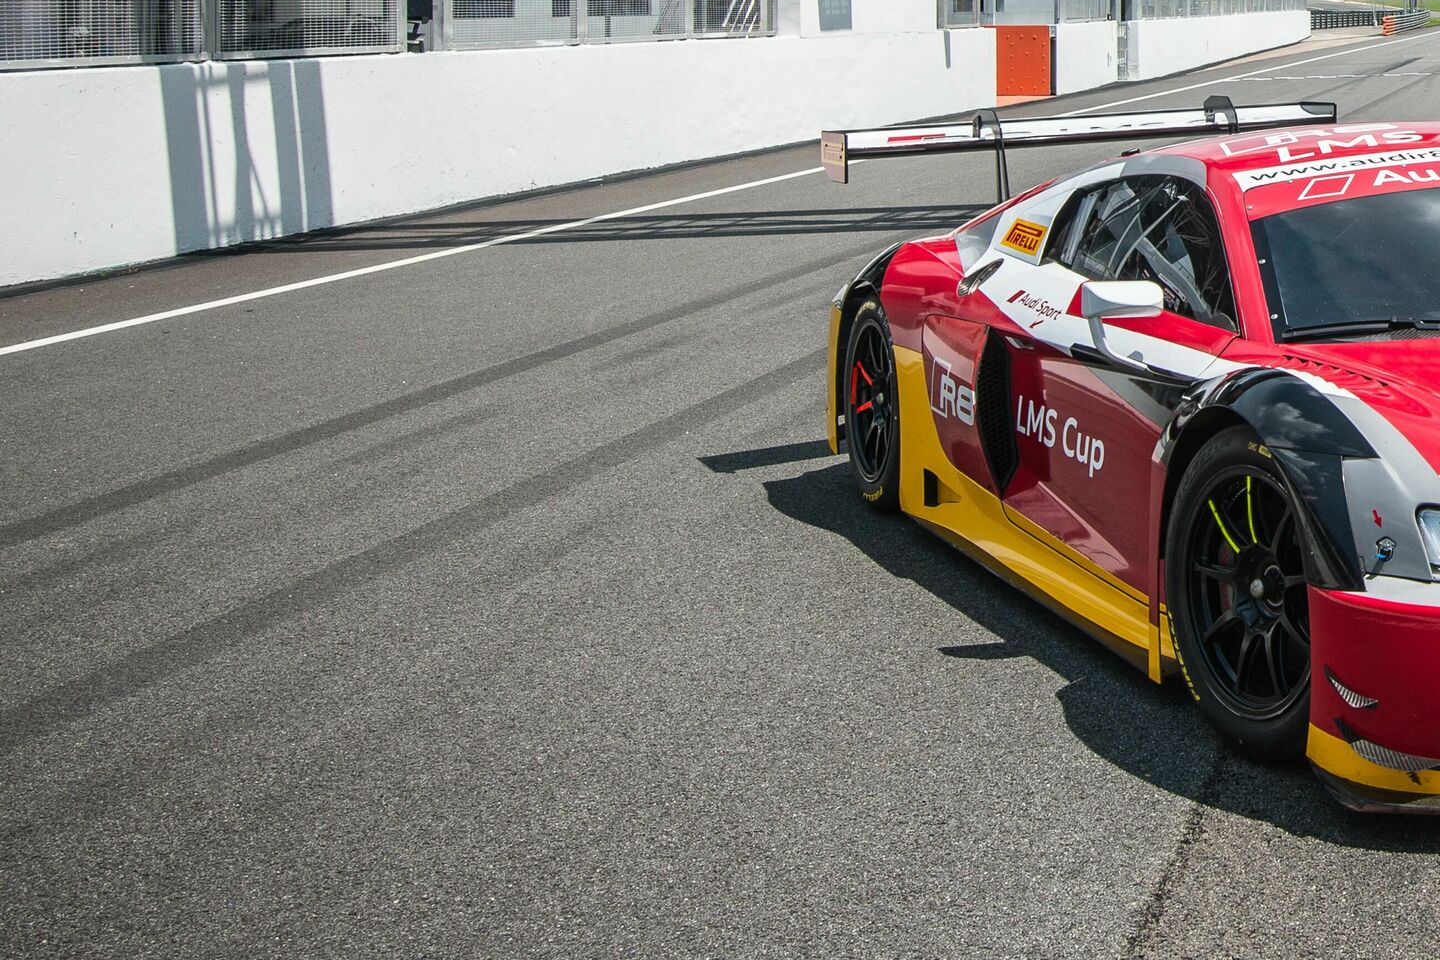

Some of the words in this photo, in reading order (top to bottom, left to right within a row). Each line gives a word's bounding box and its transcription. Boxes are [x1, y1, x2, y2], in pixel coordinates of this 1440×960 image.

[1277, 130, 1423, 163] LMS
[1006, 223, 1043, 251] PIRELLI
[1019, 293, 1038, 310] Audi
[1036, 300, 1062, 320] Sport
[939, 373, 975, 426] R8
[1017, 395, 1058, 448] LMS
[1062, 416, 1105, 478] Cup
